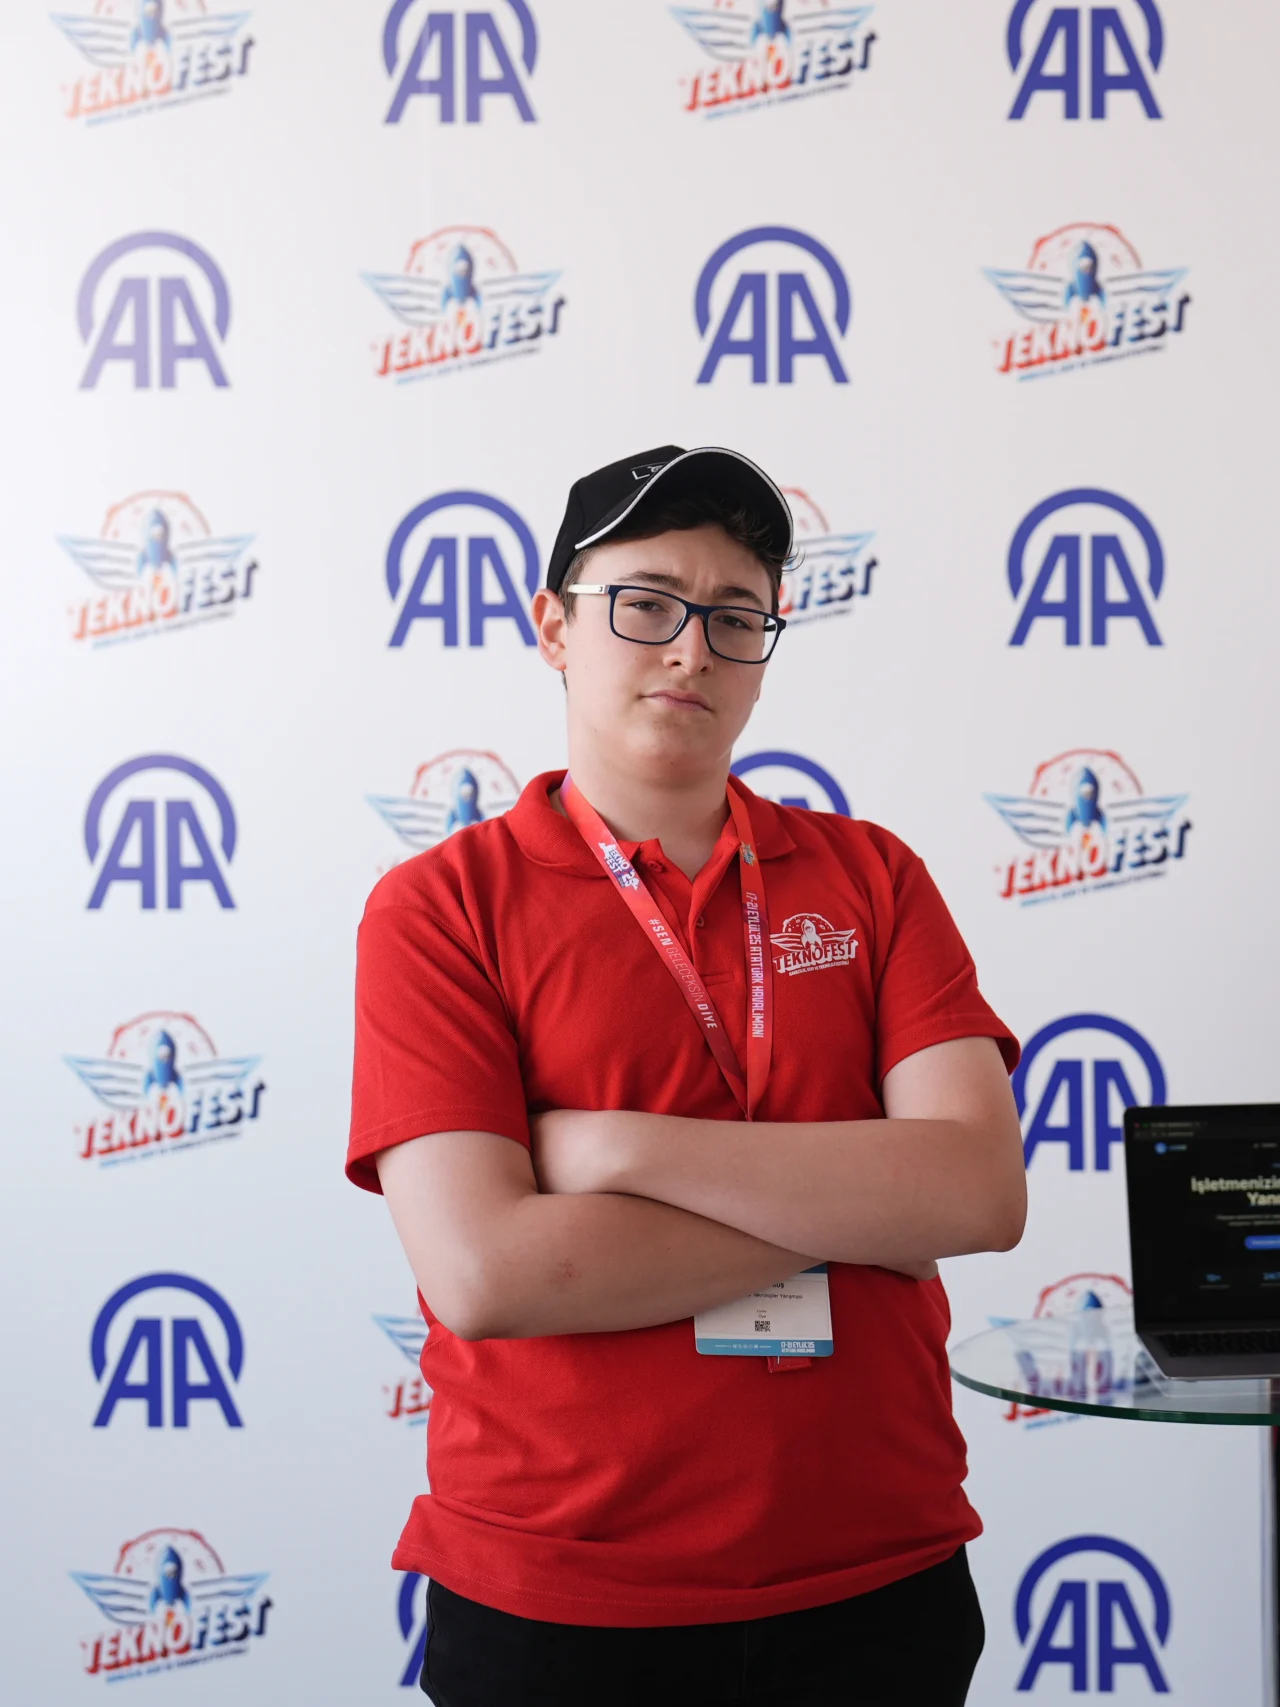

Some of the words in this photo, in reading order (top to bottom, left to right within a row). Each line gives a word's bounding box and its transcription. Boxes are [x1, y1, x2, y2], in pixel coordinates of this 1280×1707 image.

[57, 36, 255, 118] TEKNOFEST
[387, 13, 535, 123] AA
[676, 30, 878, 113] TEKNOFEST
[1009, 7, 1162, 120] AA
[78, 278, 230, 388] AA
[368, 295, 566, 377] TEKNOFEST
[697, 273, 849, 385] AA
[990, 292, 1192, 375] TEKNOFEST
[65, 560, 260, 641] TEKNOFEST
[389, 537, 538, 647] AA
[1010, 534, 1163, 647] AA
[88, 801, 236, 910] AA
[991, 818, 1193, 901] TEKNOFEST
[648, 918, 674, 946] #SEN
[697, 1003, 717, 1029] DİYE
[749, 946, 763, 984] ATATÜRK
[773, 940, 859, 974] TEKNOFEST
[751, 986, 765, 1039] HAVALİMANI
[72, 1080, 267, 1161] TEKNOFEST
[93, 1317, 245, 1429] AA
[78, 1596, 273, 1677] TEKNOFEST
[1017, 1580, 1171, 1694] AA
